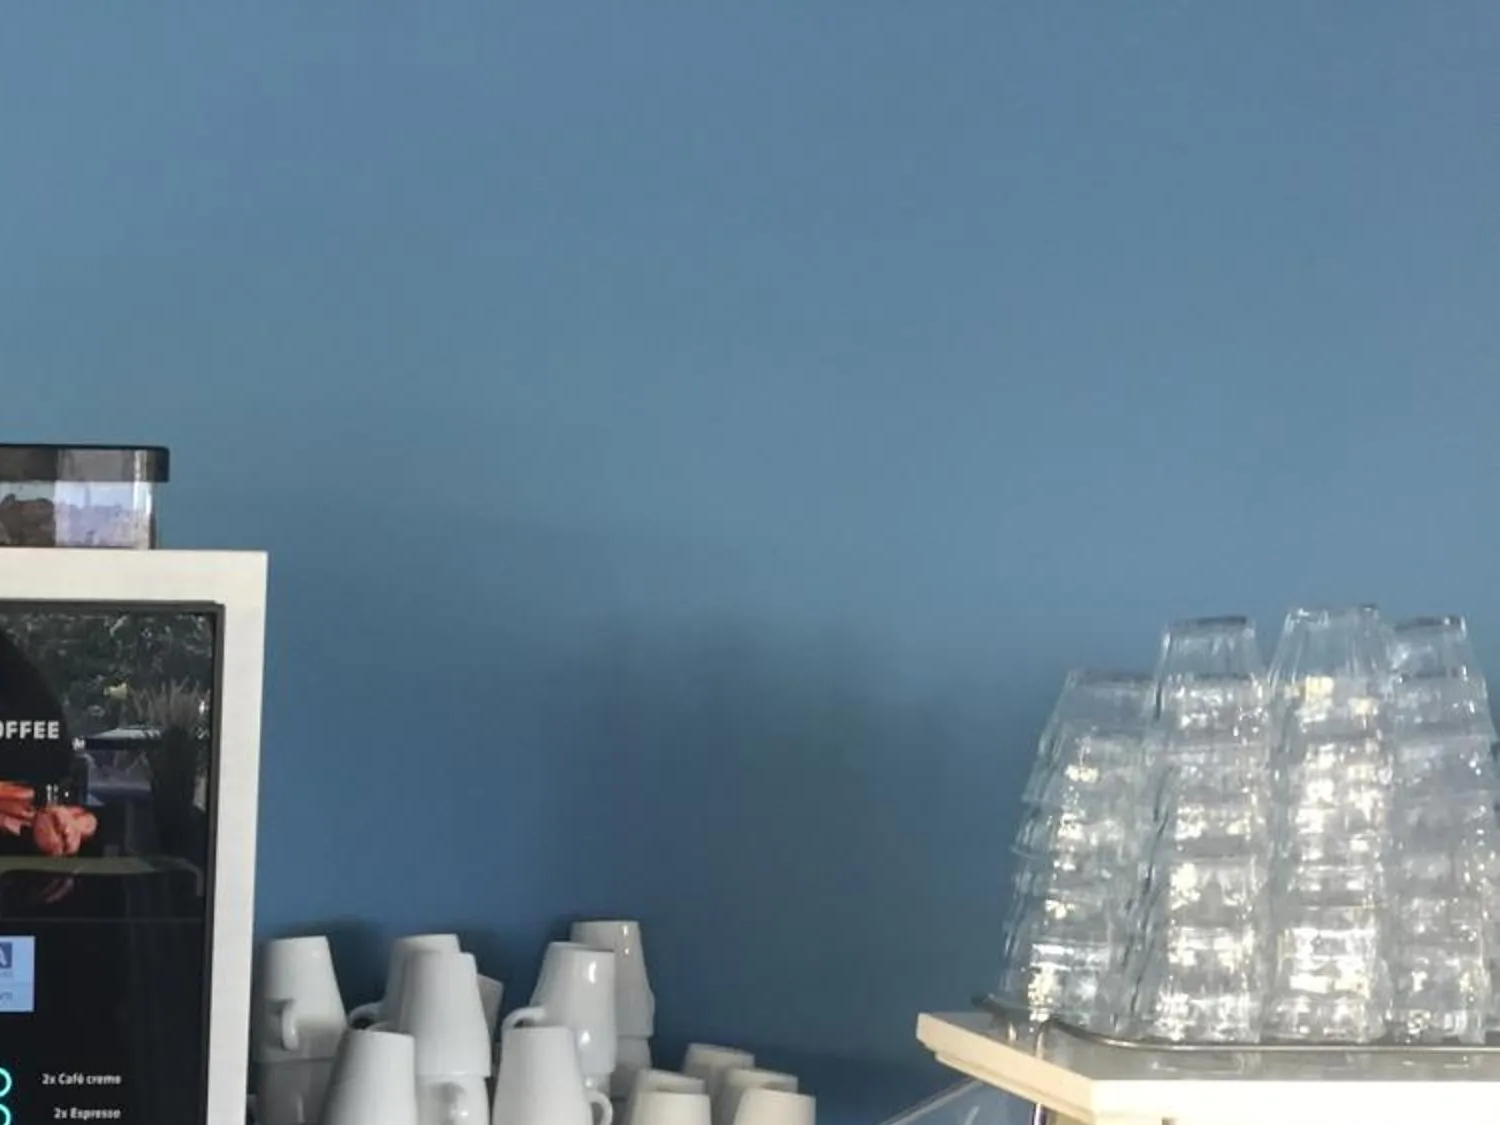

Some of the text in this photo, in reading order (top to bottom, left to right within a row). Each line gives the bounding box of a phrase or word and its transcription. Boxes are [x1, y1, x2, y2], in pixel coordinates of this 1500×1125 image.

[41, 1073, 56, 1085] 2x
[53, 1106, 122, 1121] 2x Espresso
